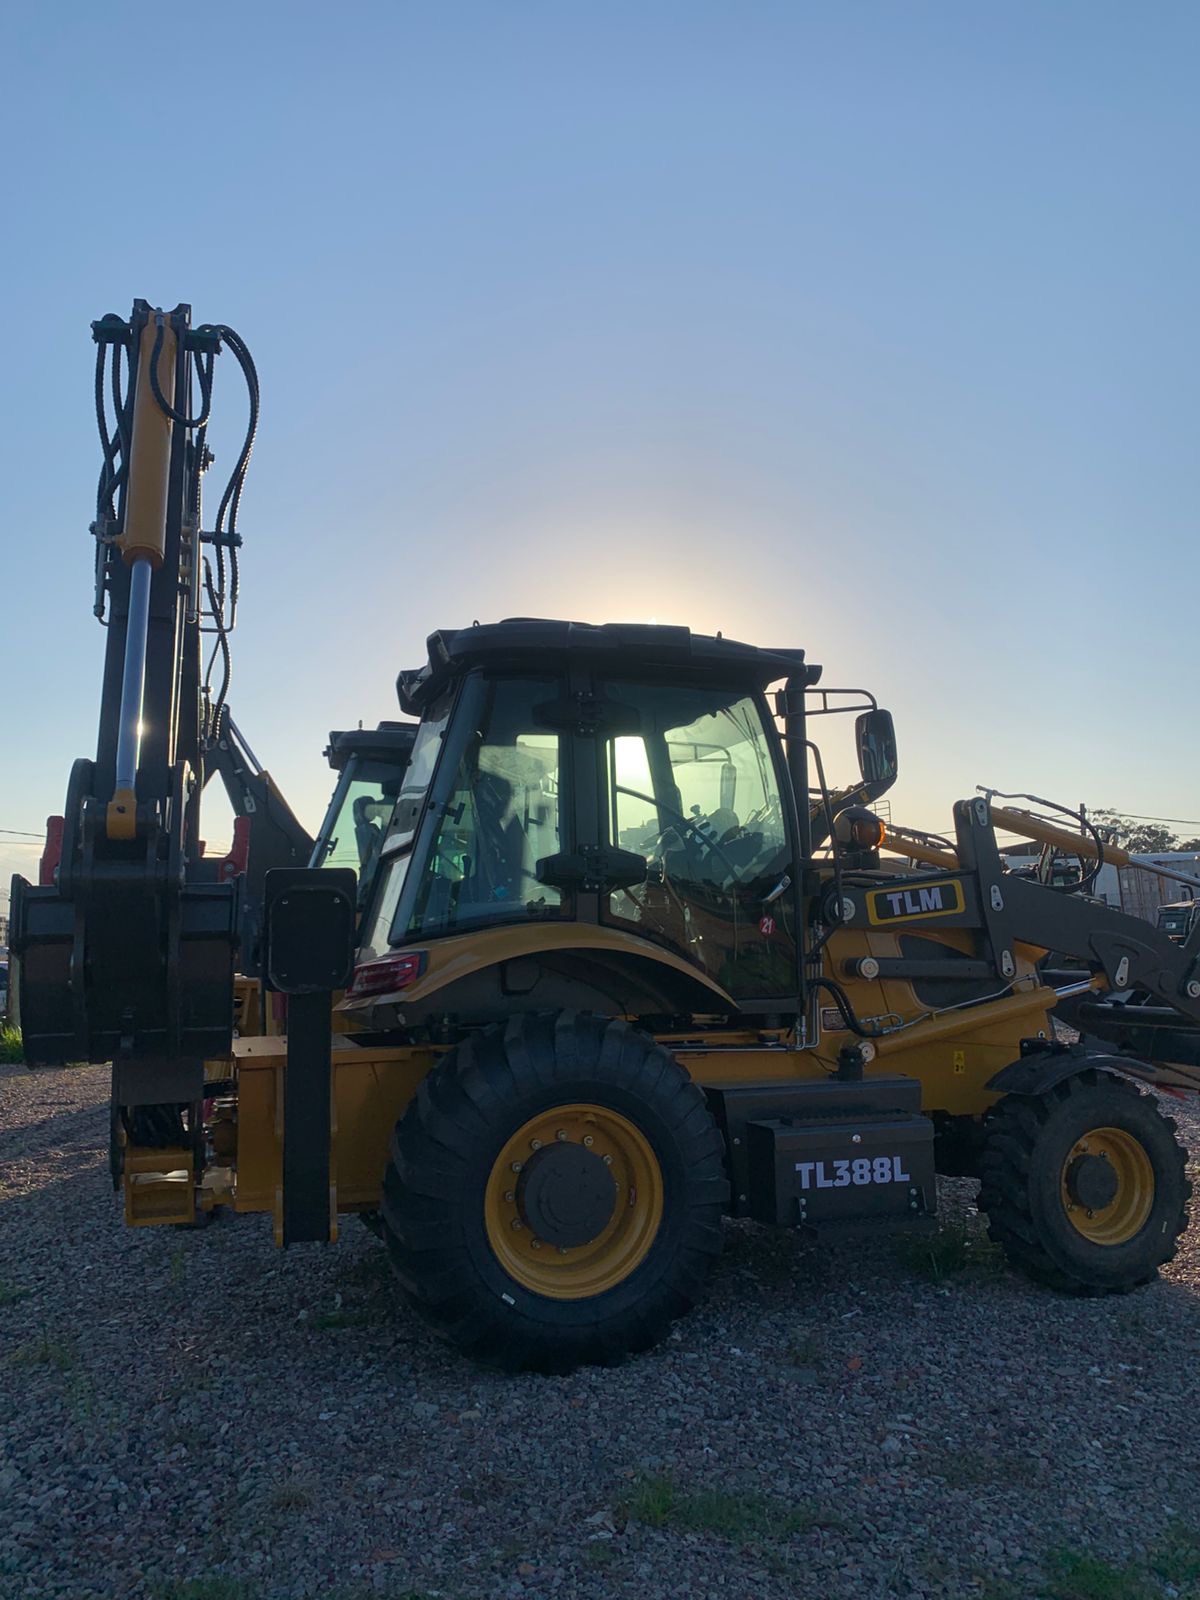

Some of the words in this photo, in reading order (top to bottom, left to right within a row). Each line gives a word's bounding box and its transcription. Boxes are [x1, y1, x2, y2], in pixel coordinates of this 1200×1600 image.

[886, 887, 943, 916] TLM
[761, 917, 774, 934] 21
[795, 1156, 910, 1189] TL388L
